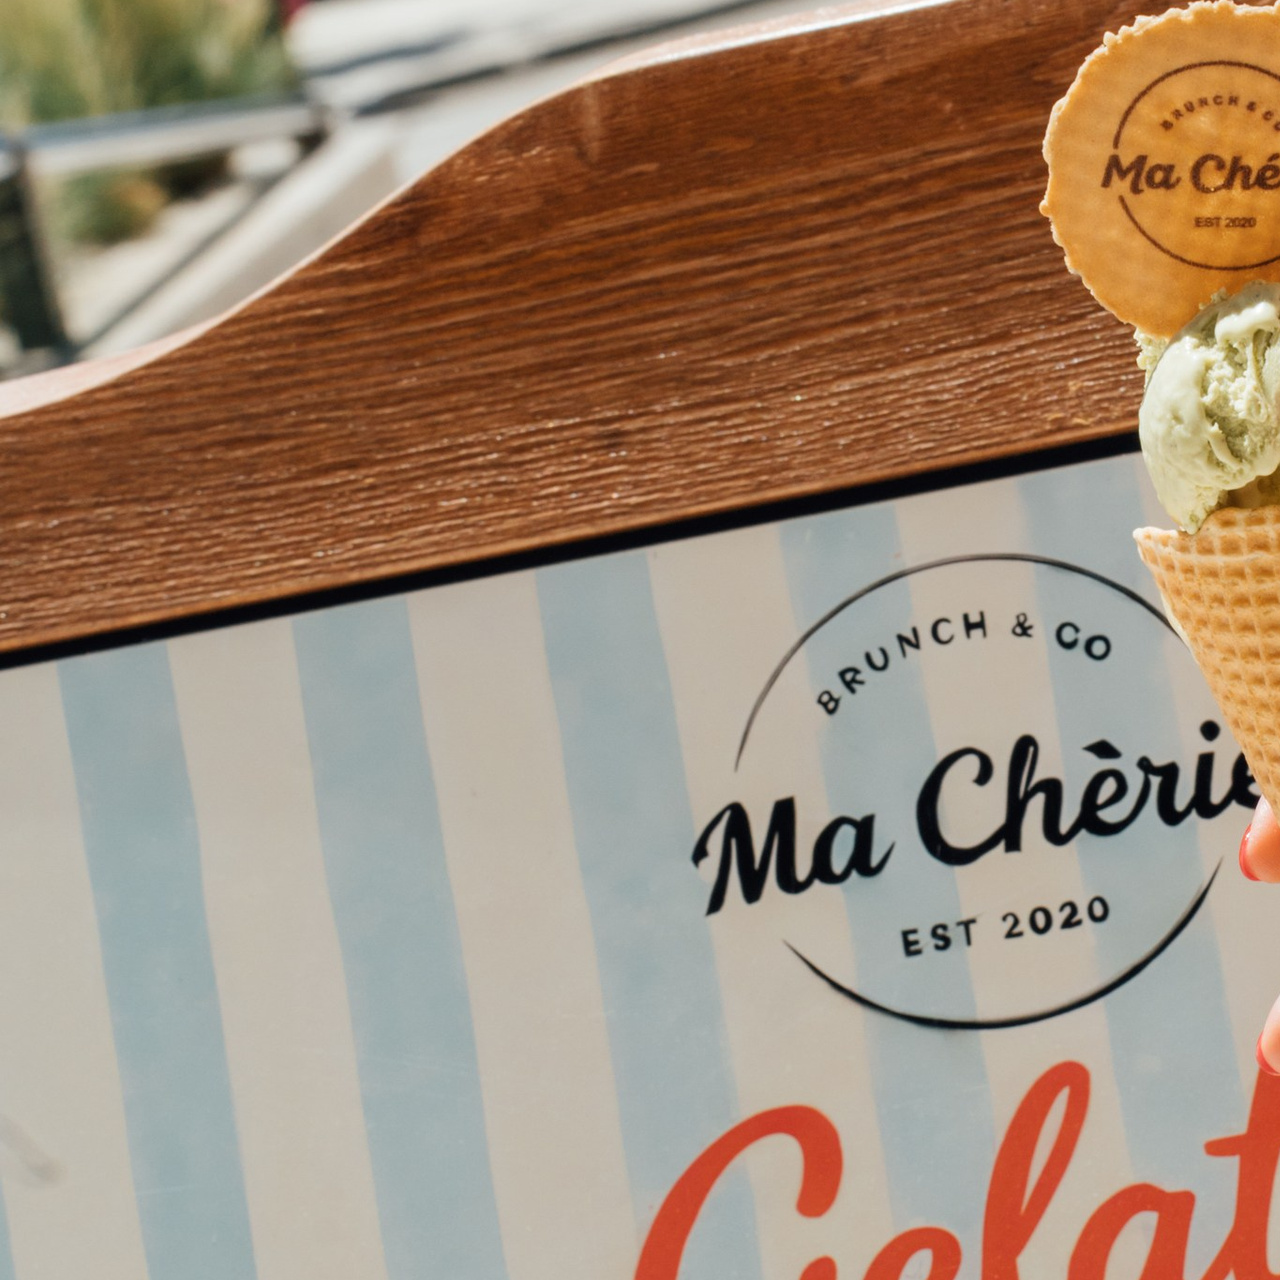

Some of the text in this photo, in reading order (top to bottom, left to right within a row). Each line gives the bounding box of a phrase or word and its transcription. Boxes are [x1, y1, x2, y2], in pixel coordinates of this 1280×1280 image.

[1160, 94, 1240, 132] BRUNCH
[1246, 100, 1258, 112] &
[1100, 154, 1181, 195] Ma
[1194, 216, 1257, 229] EST 2020
[816, 611, 1113, 716] BRUNCH & CO
[691, 795, 896, 917] Ma
[901, 896, 1111, 958] EST 2020
